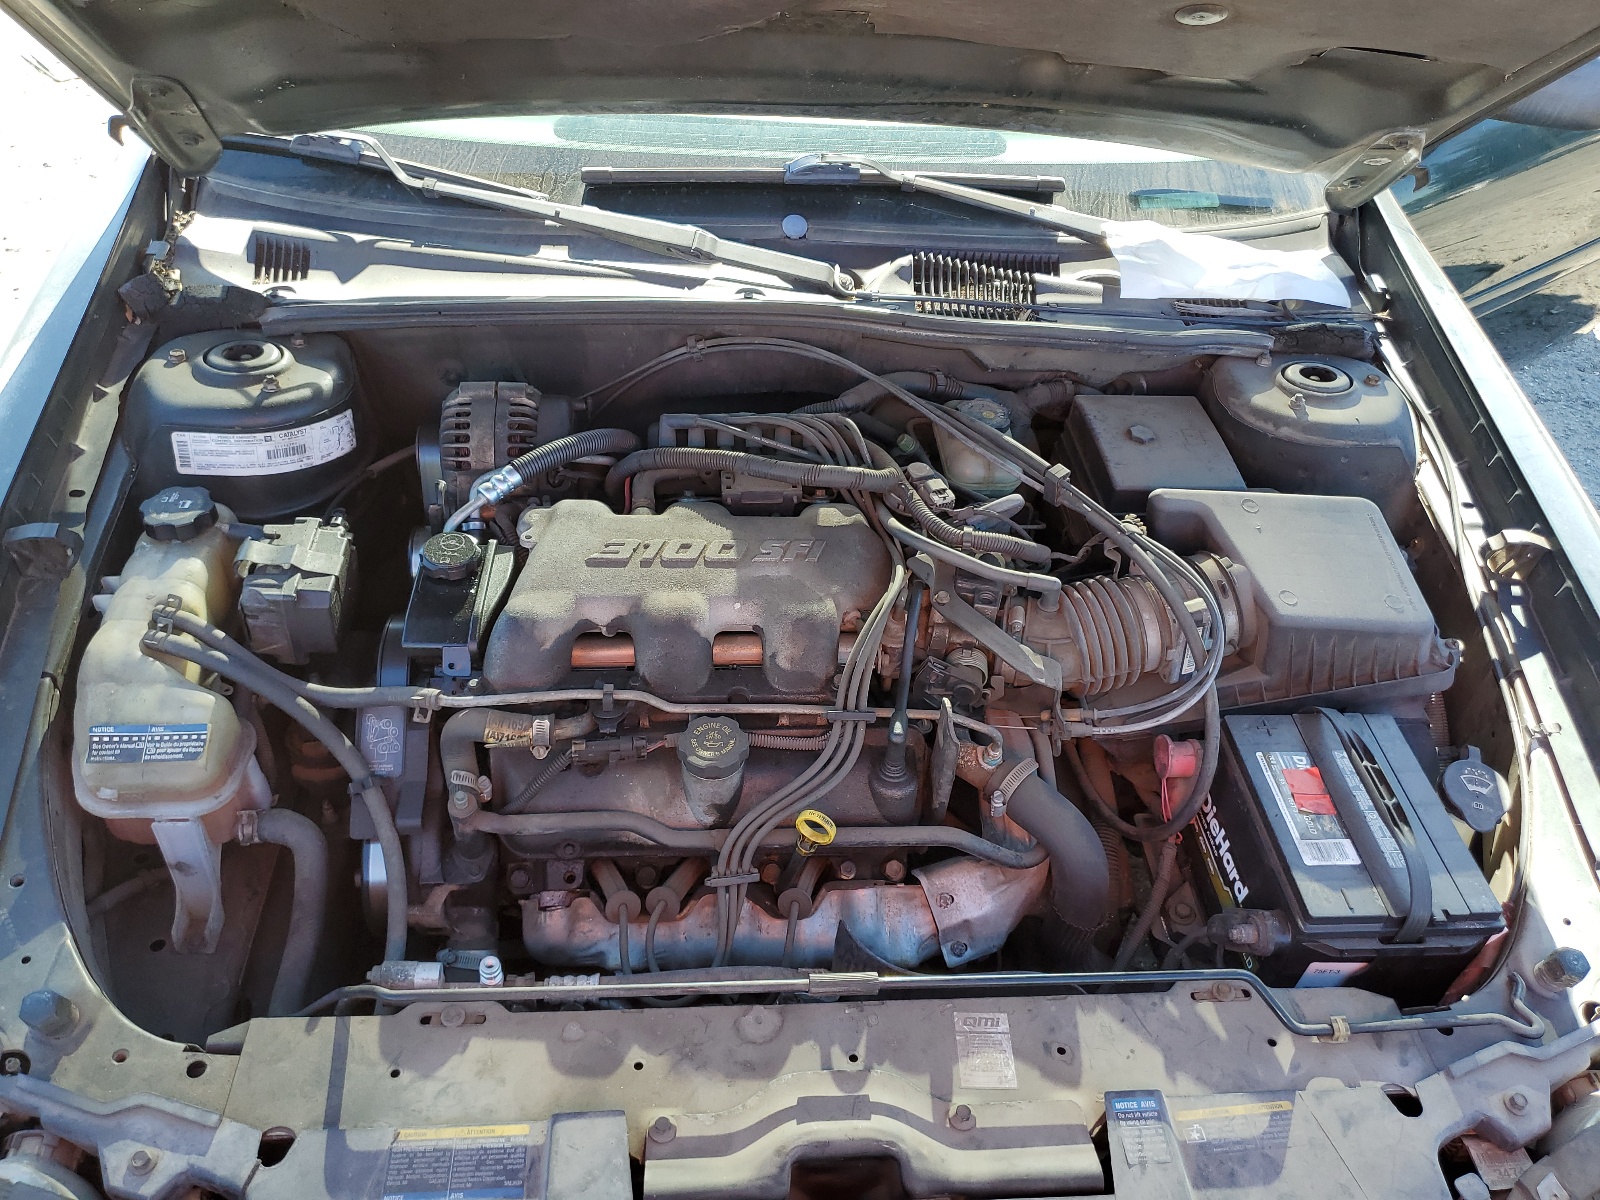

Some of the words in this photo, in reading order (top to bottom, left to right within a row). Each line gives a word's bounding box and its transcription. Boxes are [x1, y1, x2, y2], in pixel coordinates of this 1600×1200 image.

[279, 428, 307, 438] CATALYST
[585, 539, 749, 568] 3100
[751, 539, 827, 563] SFI
[693, 722, 722, 736] ENGINE
[1304, 815, 1318, 835] GOLD
[1140, 1100, 1156, 1108] AVIS
[466, 1128, 496, 1136] ATTENTION
